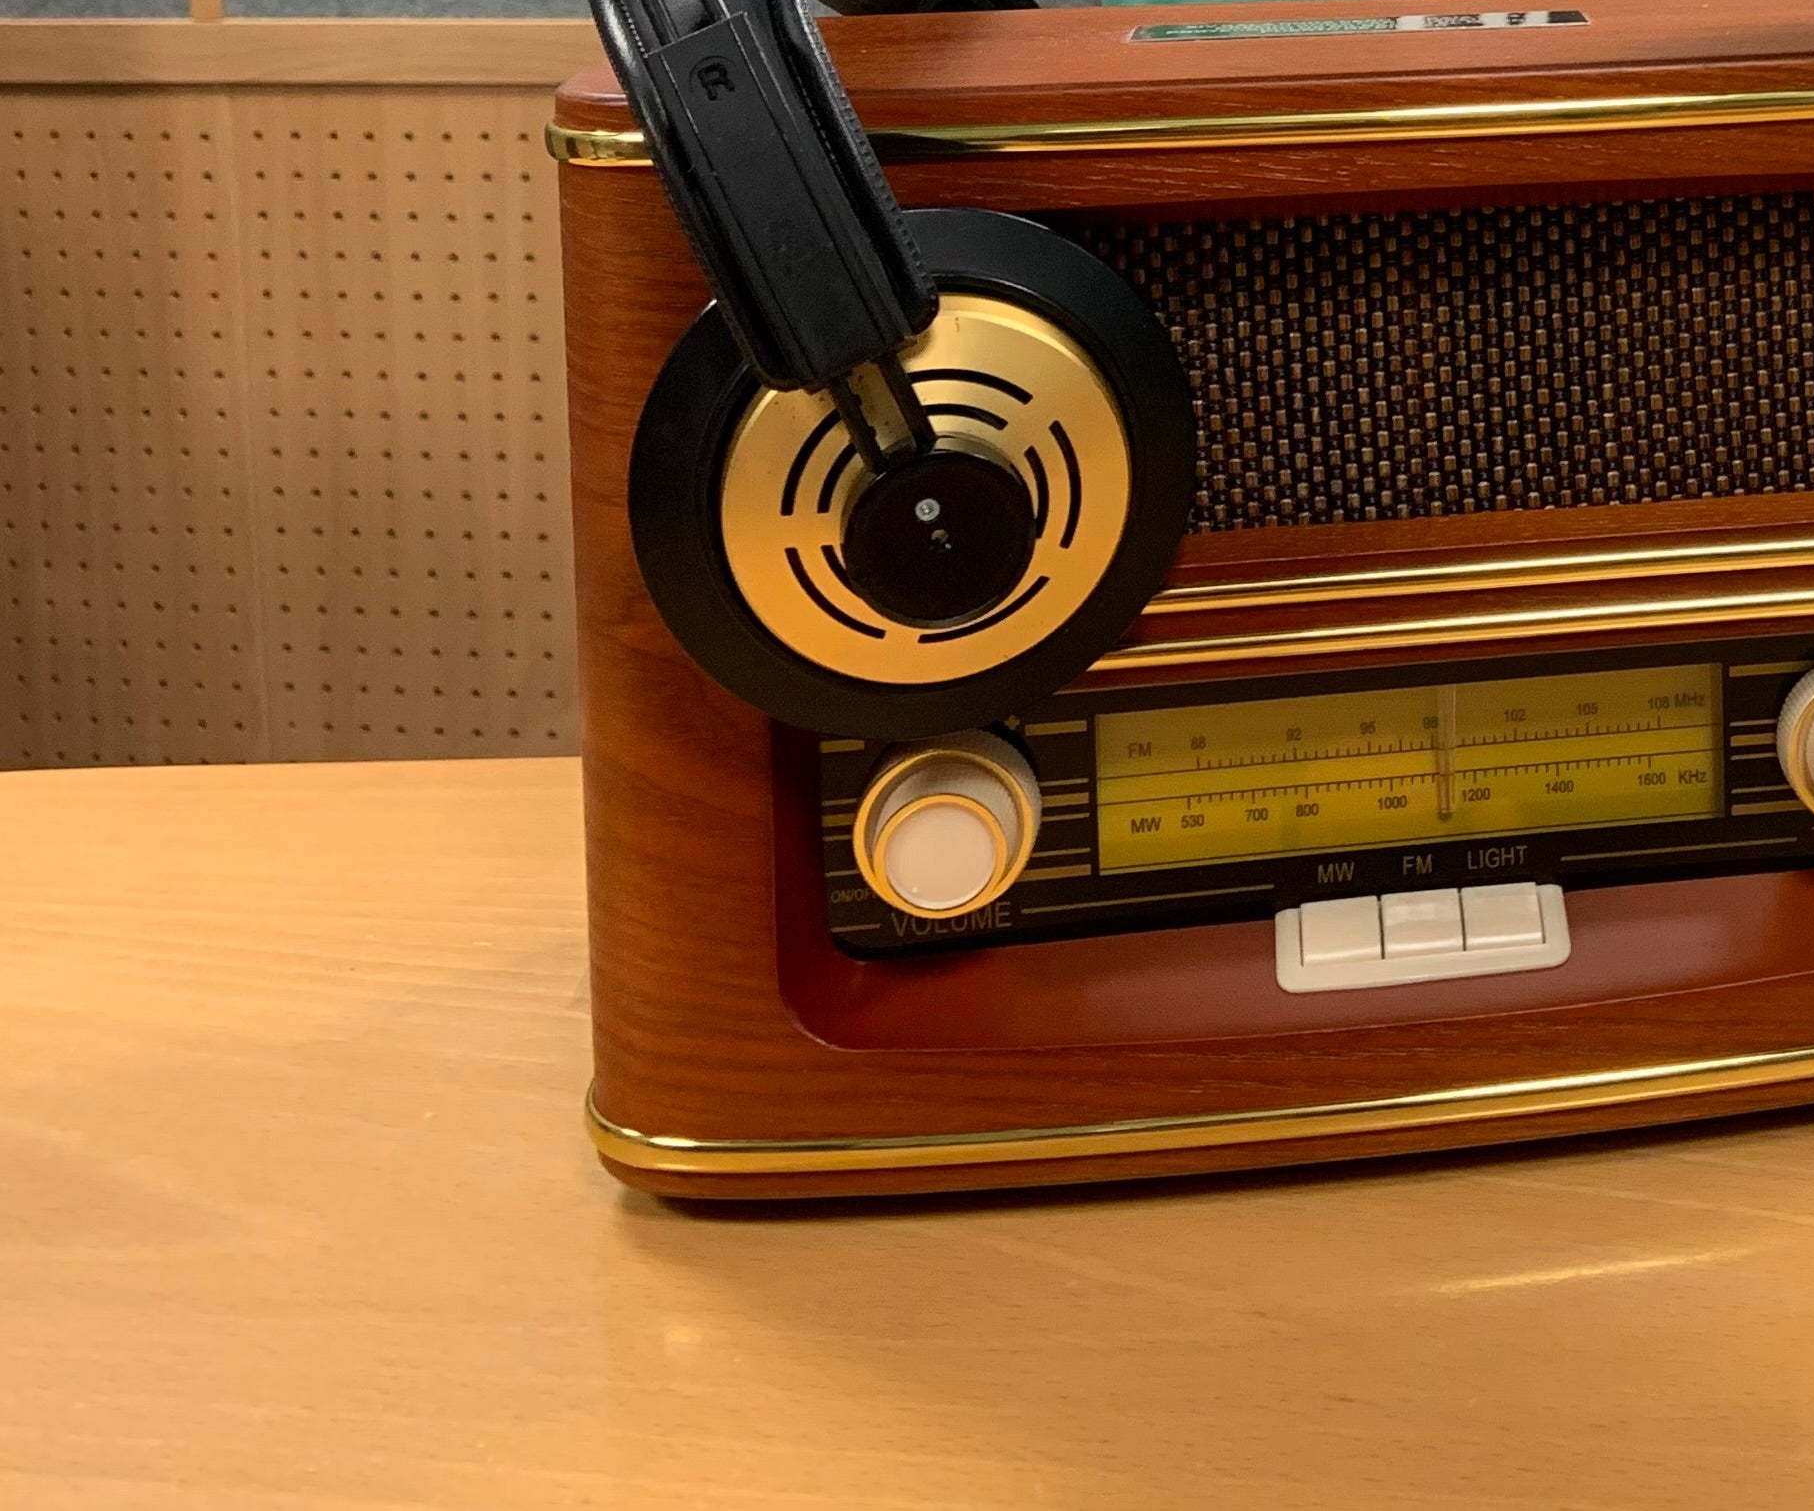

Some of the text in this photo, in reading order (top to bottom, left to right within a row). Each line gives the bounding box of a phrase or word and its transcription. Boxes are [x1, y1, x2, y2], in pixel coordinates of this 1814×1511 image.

[1128, 741, 1152, 758] FM
[1286, 728, 1302, 742] 92
[1359, 720, 1376, 735] 95
[1504, 708, 1526, 722] 102
[1577, 702, 1599, 716] 105
[1649, 696, 1670, 710] 108
[1674, 692, 1705, 708] MHz
[1131, 769, 1708, 834] MW 530 700 800 1000 1200 1400 1600 KHz
[1317, 845, 1528, 884] MW FM LIGHT
